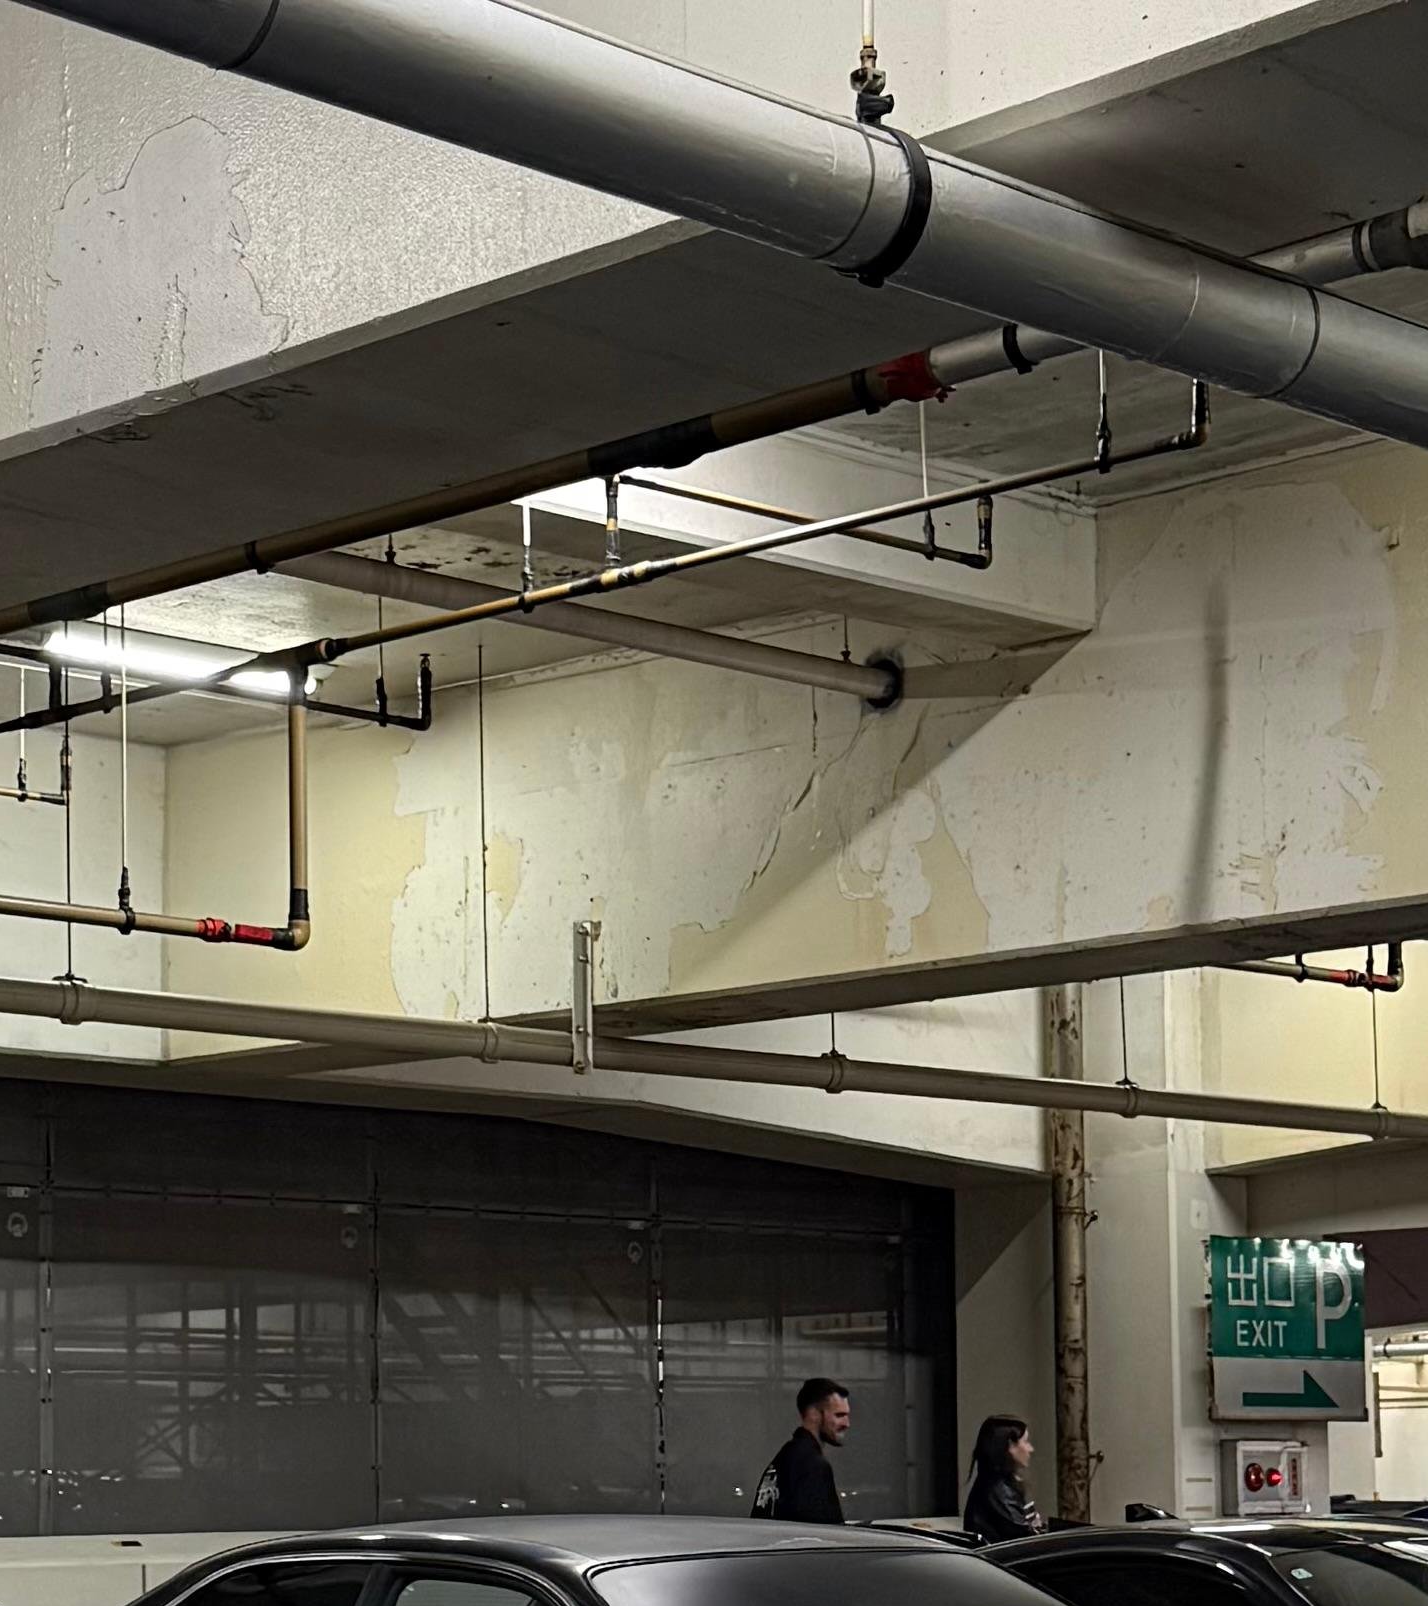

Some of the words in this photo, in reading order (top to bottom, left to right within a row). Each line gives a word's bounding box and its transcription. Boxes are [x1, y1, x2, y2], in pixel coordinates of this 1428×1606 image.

[1227, 1254, 1295, 1307] 出口
[1316, 1257, 1353, 1350] P
[1236, 1319, 1288, 1348] EXIT
